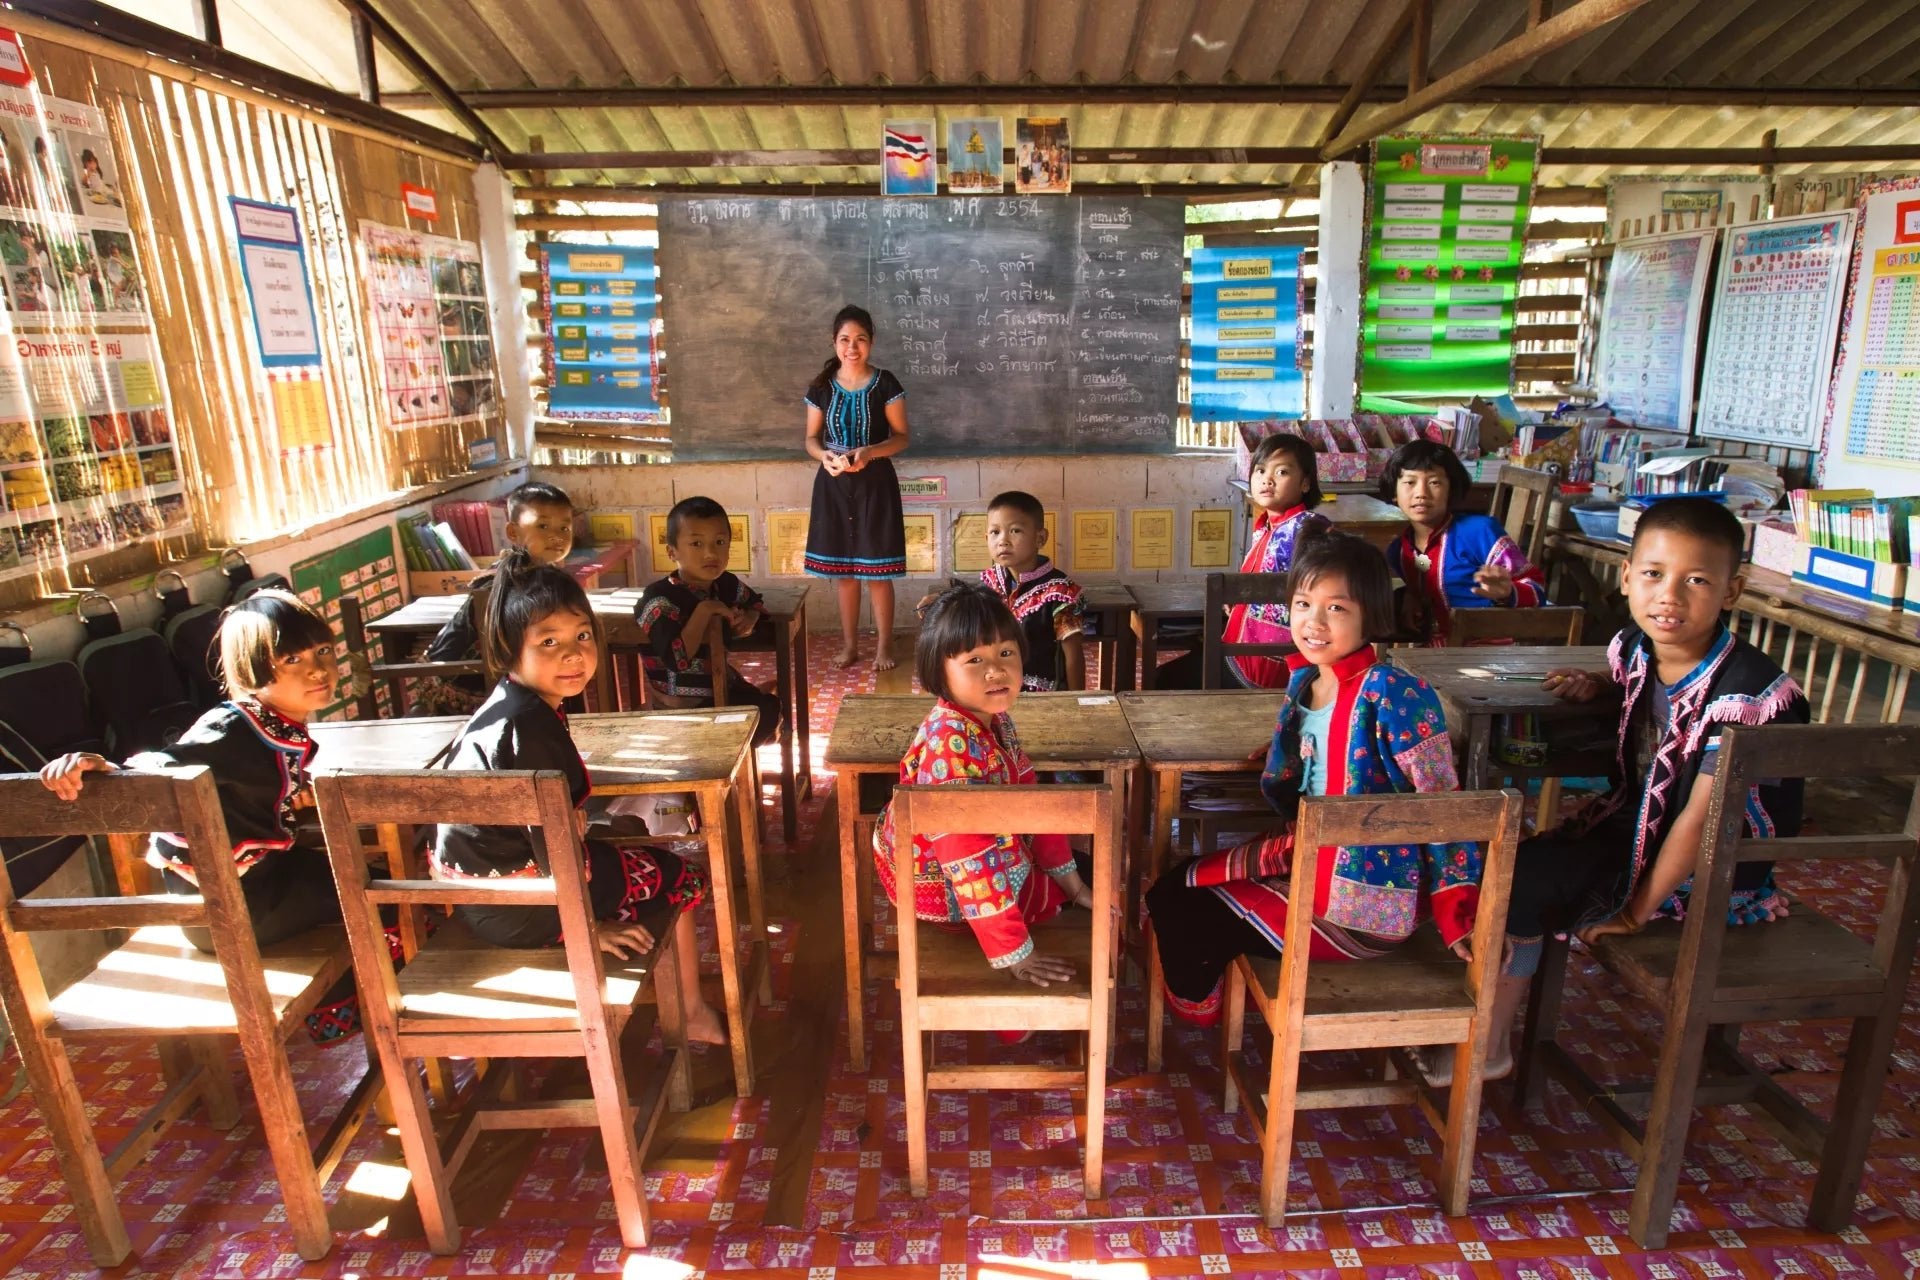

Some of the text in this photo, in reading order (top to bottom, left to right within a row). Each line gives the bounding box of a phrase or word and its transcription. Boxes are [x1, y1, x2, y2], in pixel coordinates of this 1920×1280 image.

[687, 200, 709, 224] วัน
[778, 199, 792, 221] ที่
[831, 200, 868, 220] เดือน
[882, 201, 929, 227] ตุลาคม
[996, 199, 1043, 217] 2554
[998, 252, 1035, 281] ลูกค้า
[1825, 258, 1830, 266] 5
[1000, 280, 1056, 302] วงเวียน
[1819, 281, 1827, 289] 10
[896, 311, 940, 329] ลำปาง
[995, 308, 1070, 325] วัฒนธรรม
[1772, 324, 1778, 332] 32
[1789, 324, 1796, 332] 33
[997, 328, 1047, 347] วิถีชีวิต
[90, 339, 100, 355] 5
[105, 340, 122, 359] หมู่
[998, 354, 1057, 372] วิทยากร
